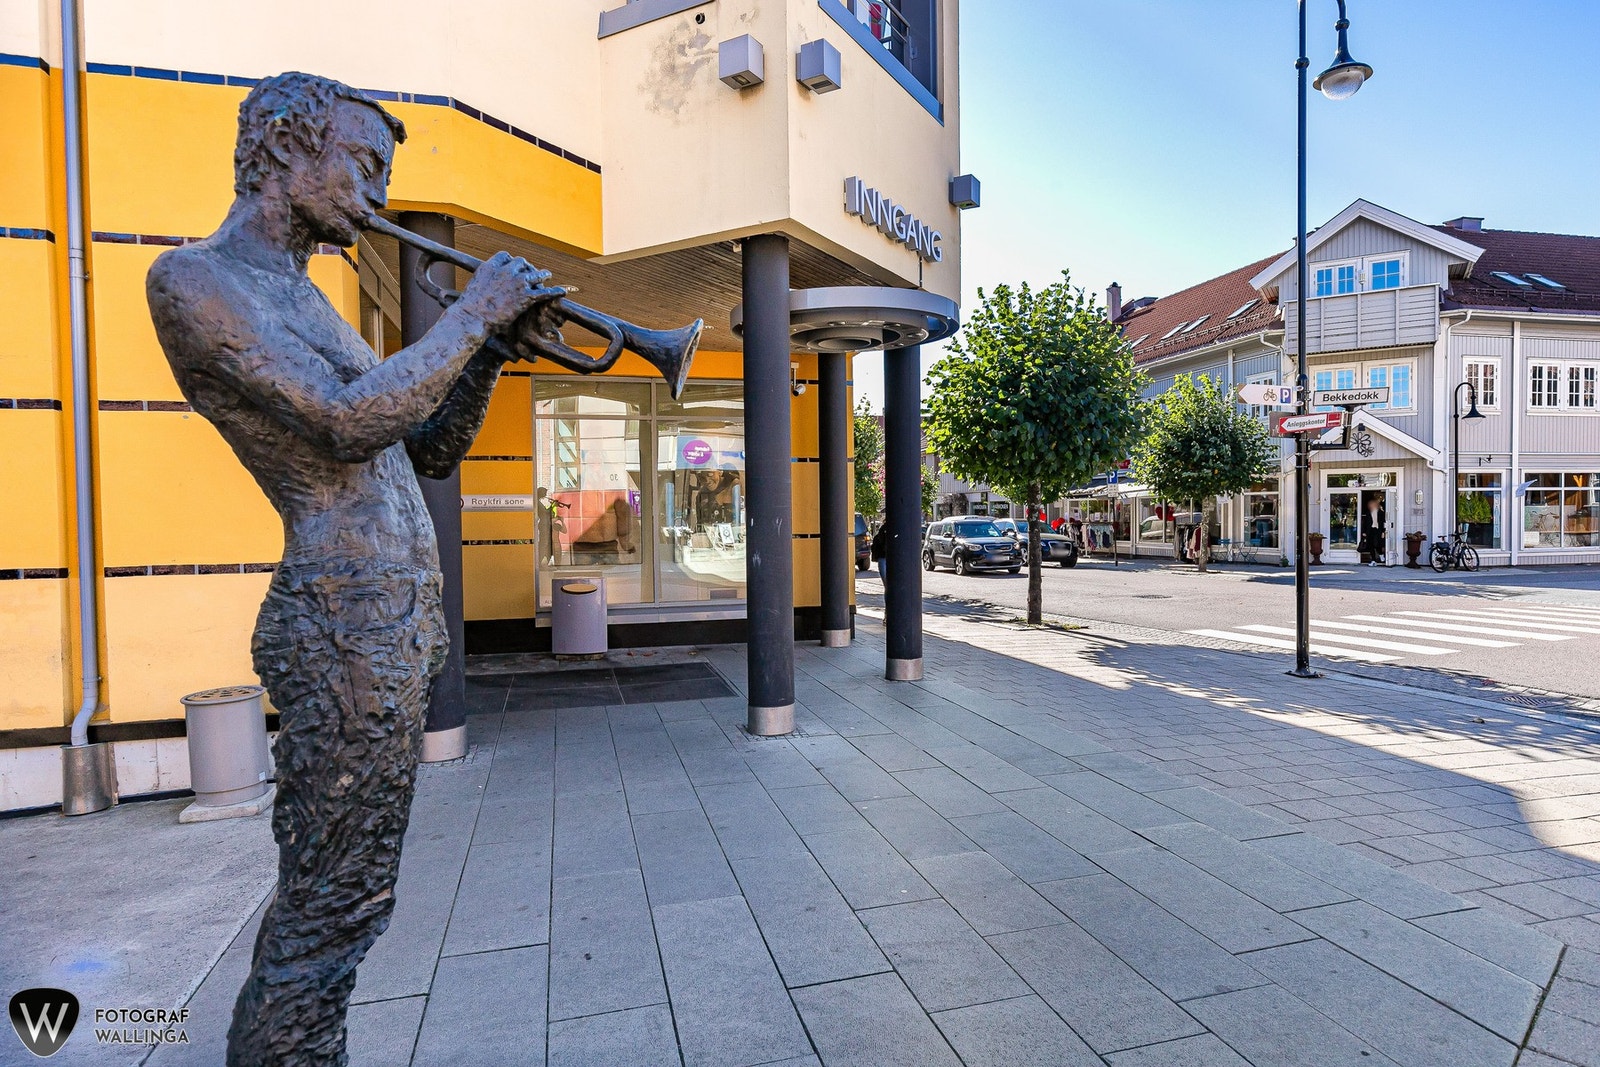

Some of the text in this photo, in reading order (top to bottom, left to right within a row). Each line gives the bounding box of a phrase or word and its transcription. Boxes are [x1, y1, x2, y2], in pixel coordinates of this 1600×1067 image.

[845, 176, 942, 262] INNGANG
[1283, 391, 1288, 402] P
[1322, 391, 1379, 402] Bekkedokk
[1110, 471, 1116, 482] P
